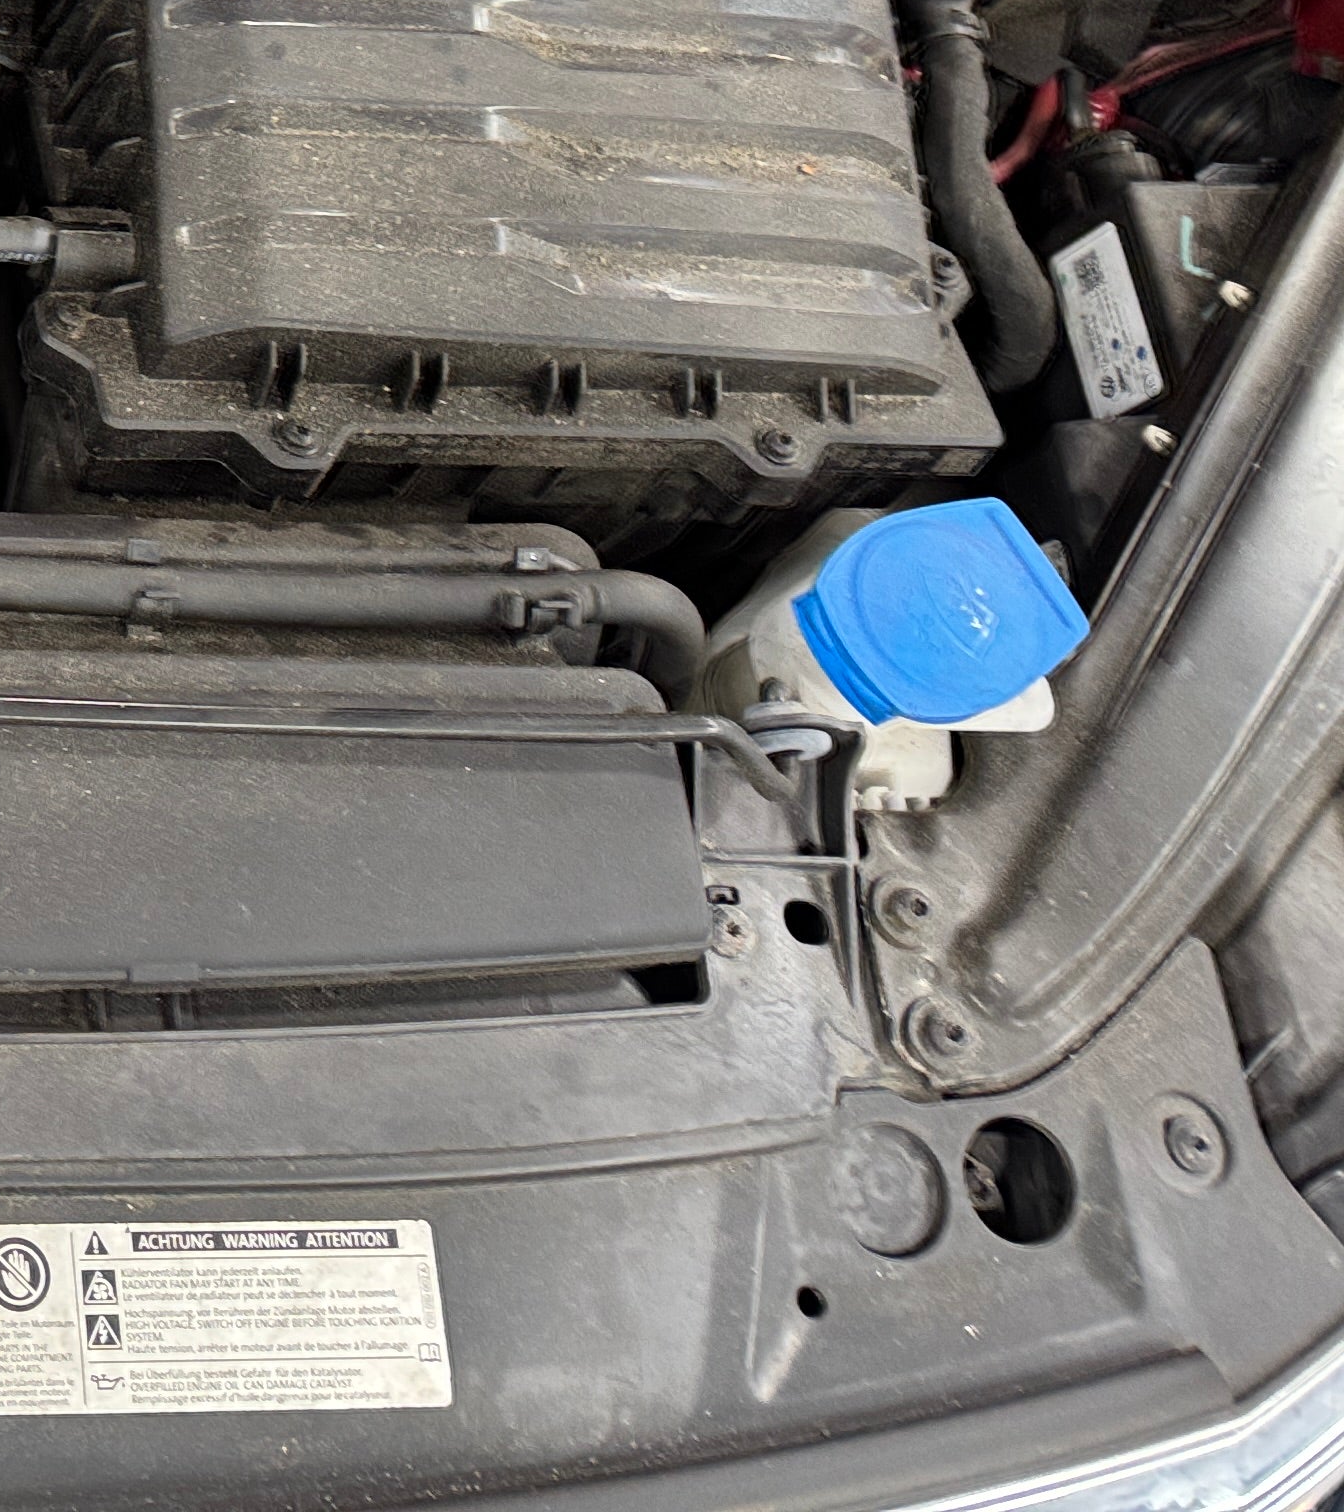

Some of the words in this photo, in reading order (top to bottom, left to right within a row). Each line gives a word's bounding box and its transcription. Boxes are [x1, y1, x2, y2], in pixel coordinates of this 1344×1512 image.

[137, 1233, 215, 1251] ACHTUNG
[221, 1232, 298, 1250] WARNING
[305, 1230, 389, 1248] ATTENTION
[122, 1279, 167, 1289] RADIATOR
[169, 1279, 188, 1289] FAN
[213, 1278, 241, 1288] START
[242, 1278, 253, 1288] AT
[256, 1278, 276, 1287] ANY
[126, 1320, 150, 1330] HIGH
[197, 1319, 233, 1329] SWITCH
[235, 1319, 253, 1329] OFF
[254, 1318, 289, 1328] ENGINE
[292, 1317, 326, 1328] BEFORE
[328, 1316, 378, 1327] TOUCHING
[380, 1316, 422, 1326] IGNITION
